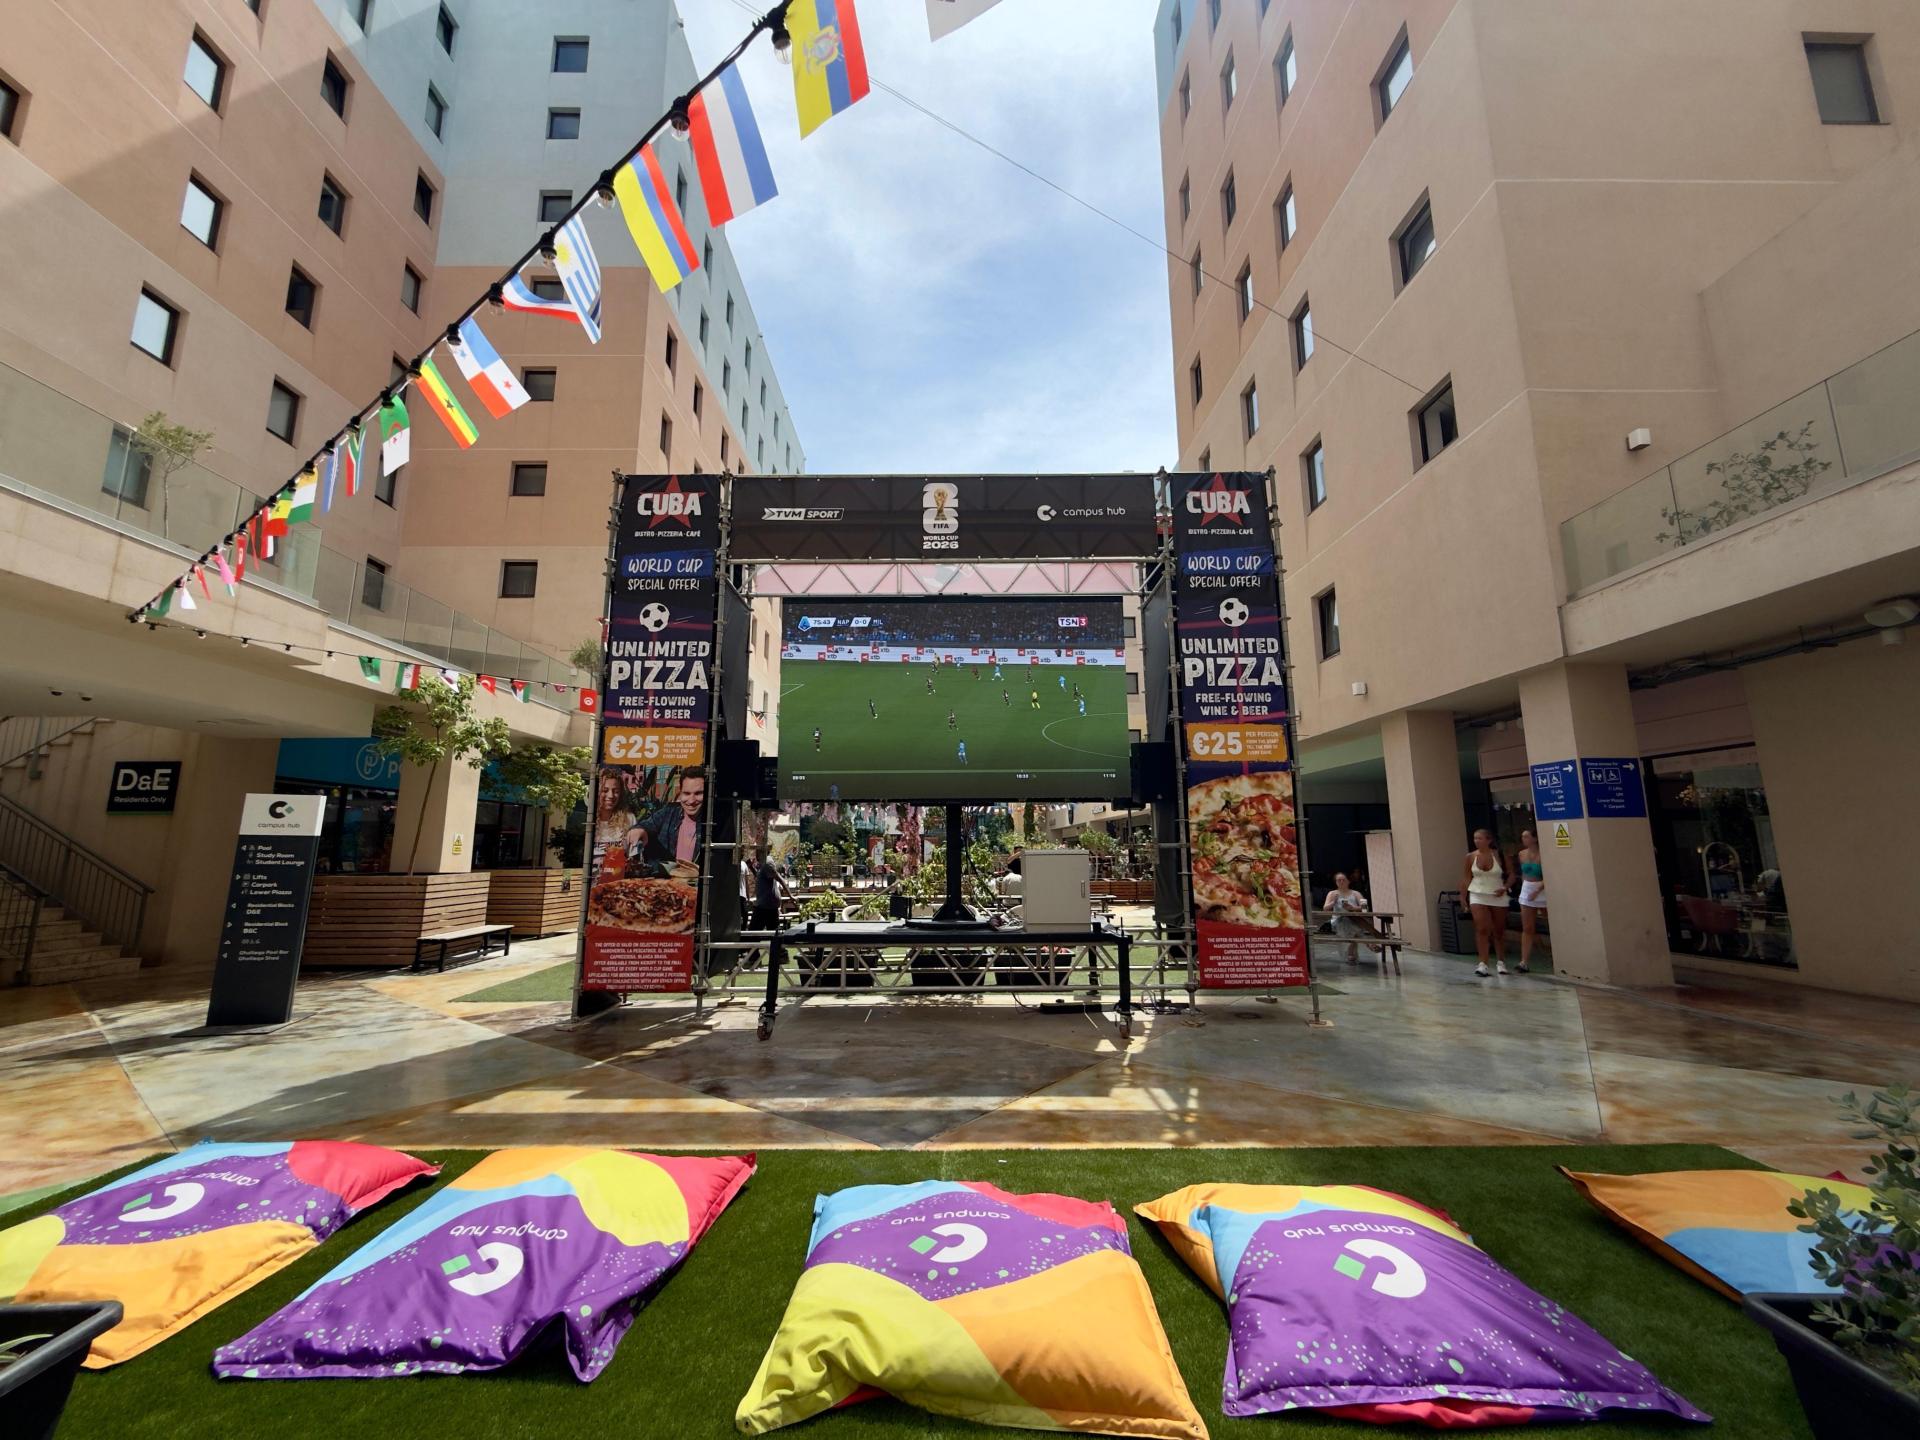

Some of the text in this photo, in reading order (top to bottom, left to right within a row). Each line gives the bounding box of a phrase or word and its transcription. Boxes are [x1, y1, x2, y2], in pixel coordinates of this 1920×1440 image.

[637, 493, 701, 516] CUBA
[1185, 491, 1251, 513] CUBA
[1063, 507, 1125, 517] campus hub
[923, 541, 959, 549] 2026
[628, 559, 703, 573] WORLD CUP
[1188, 556, 1261, 571] WORLD CUP
[628, 579, 700, 590] SPECIAL OFFER!
[1190, 576, 1261, 588] SPECIAL OFFER!
[611, 640, 709, 657] UNLIMITED
[1181, 638, 1279, 654] UNLIMITED
[610, 660, 709, 690] PIZZA
[1184, 657, 1283, 686] PIZZA
[619, 696, 696, 706] FREE-FLOWING
[1196, 693, 1271, 703] FREE-FLOWING
[623, 709, 690, 719] WINE & BEER
[1200, 706, 1268, 715] WINE & BEER
[609, 735, 659, 758] €25
[1193, 732, 1242, 755] €25
[116, 769, 172, 790] D&E
[150, 796, 166, 804] Only
[891, 1209, 1010, 1225] campus hub
[450, 1221, 568, 1240] campus hub
[1283, 1222, 1415, 1239] campus hub
